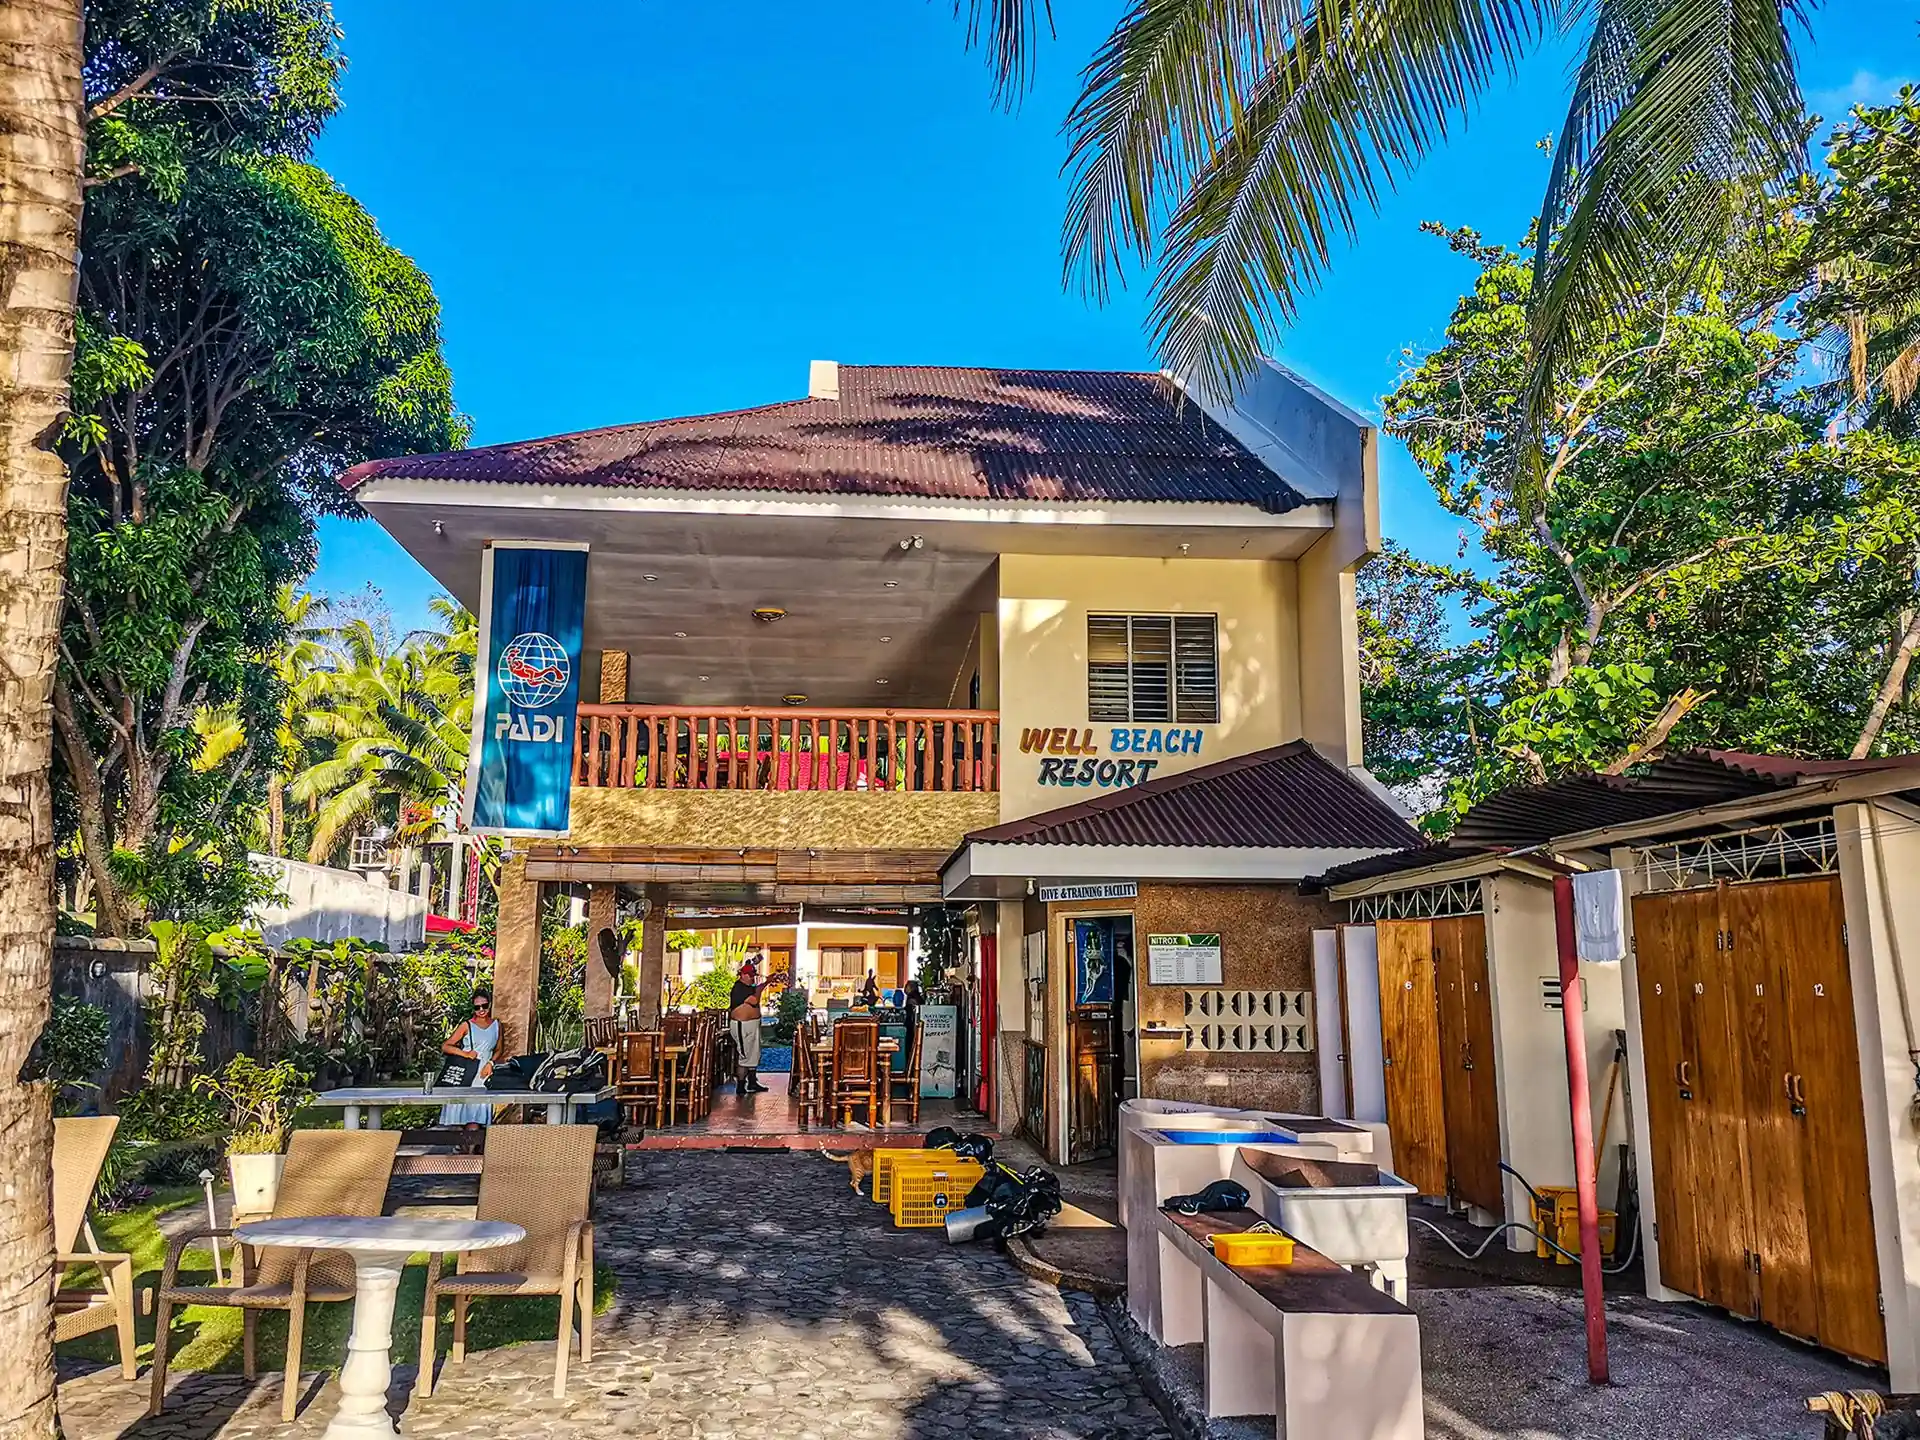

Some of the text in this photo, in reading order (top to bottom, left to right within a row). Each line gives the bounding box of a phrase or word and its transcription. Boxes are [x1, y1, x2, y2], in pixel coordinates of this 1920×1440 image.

[494, 712, 564, 743] PADI
[1019, 727, 1203, 755] WELL BEACH
[1038, 758, 1158, 787] RESORT
[1041, 888, 1059, 900] DIVE
[1104, 883, 1137, 897] FACILITY
[1151, 936, 1178, 945] NITROX
[1404, 980, 1413, 990] 6
[1655, 983, 1662, 995] 9
[1694, 982, 1704, 995] 10
[1755, 983, 1764, 996] 11
[1813, 983, 1825, 997] 12
